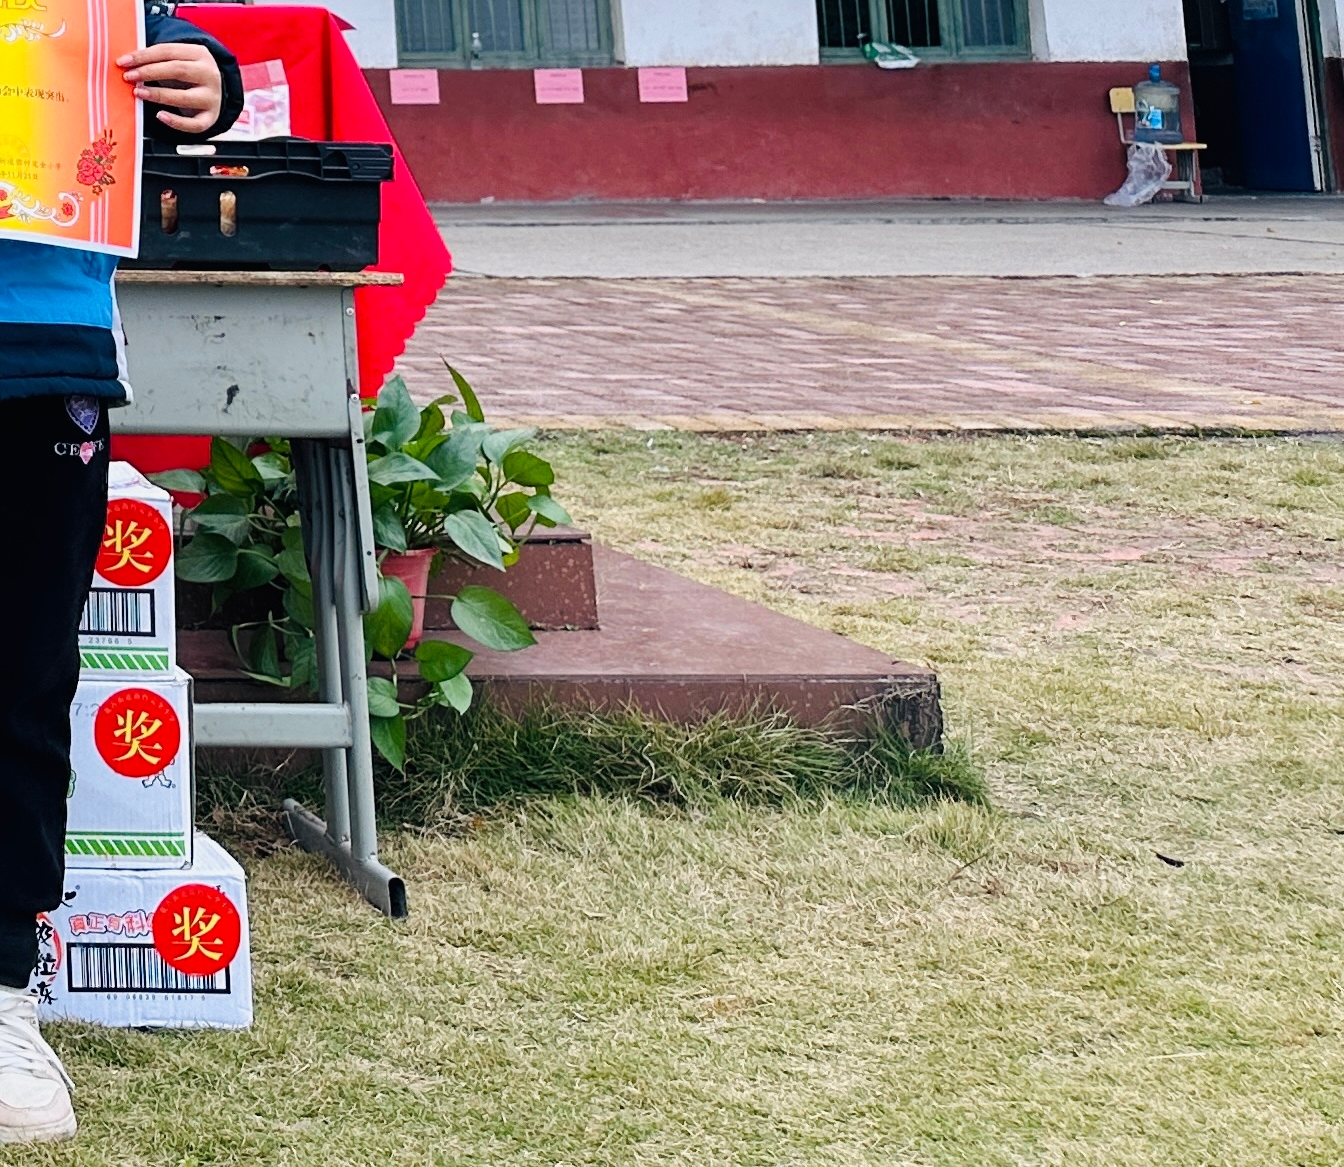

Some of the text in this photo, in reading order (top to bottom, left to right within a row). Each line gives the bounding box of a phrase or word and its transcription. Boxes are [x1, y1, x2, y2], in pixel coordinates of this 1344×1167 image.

[103, 519, 155, 574] 奖
[112, 708, 164, 765] 奖
[171, 905, 225, 963] 奖
